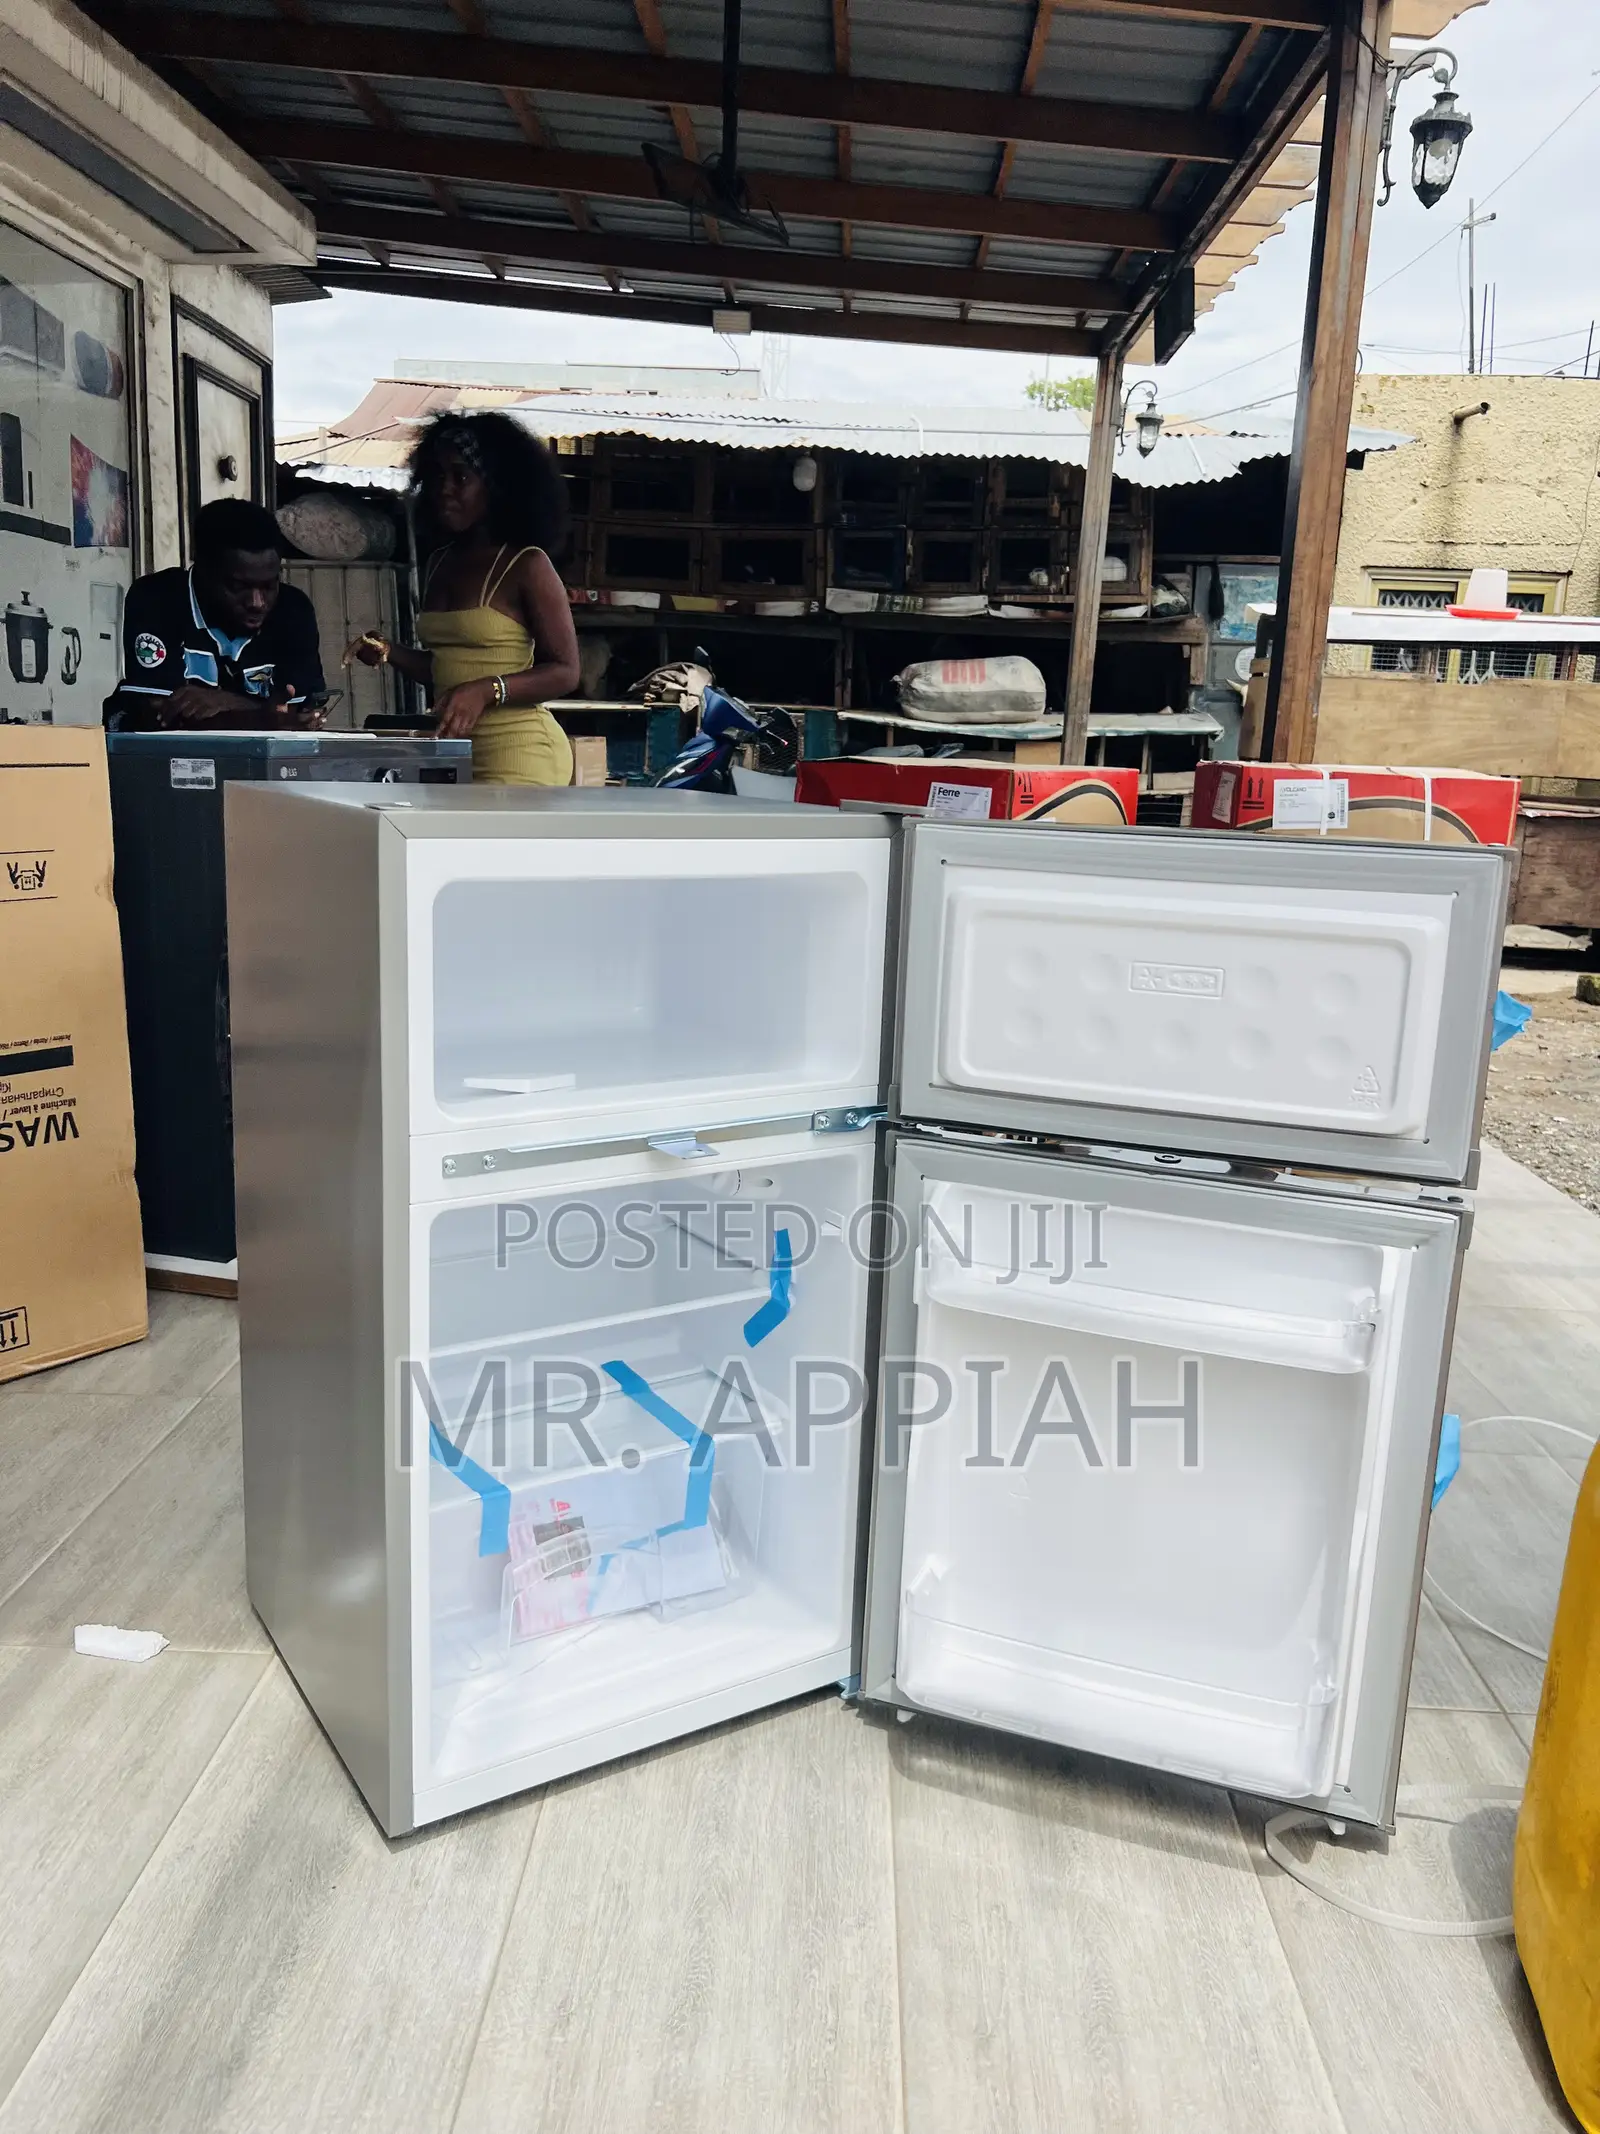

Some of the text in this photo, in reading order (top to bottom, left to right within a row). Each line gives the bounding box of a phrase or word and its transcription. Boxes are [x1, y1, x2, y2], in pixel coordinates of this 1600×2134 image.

[938, 787, 960, 797] Ferre
[1, 1087, 64, 1104] Стиральная
[40, 1097, 77, 1110] Machine
[10, 1106, 32, 1116] laver
